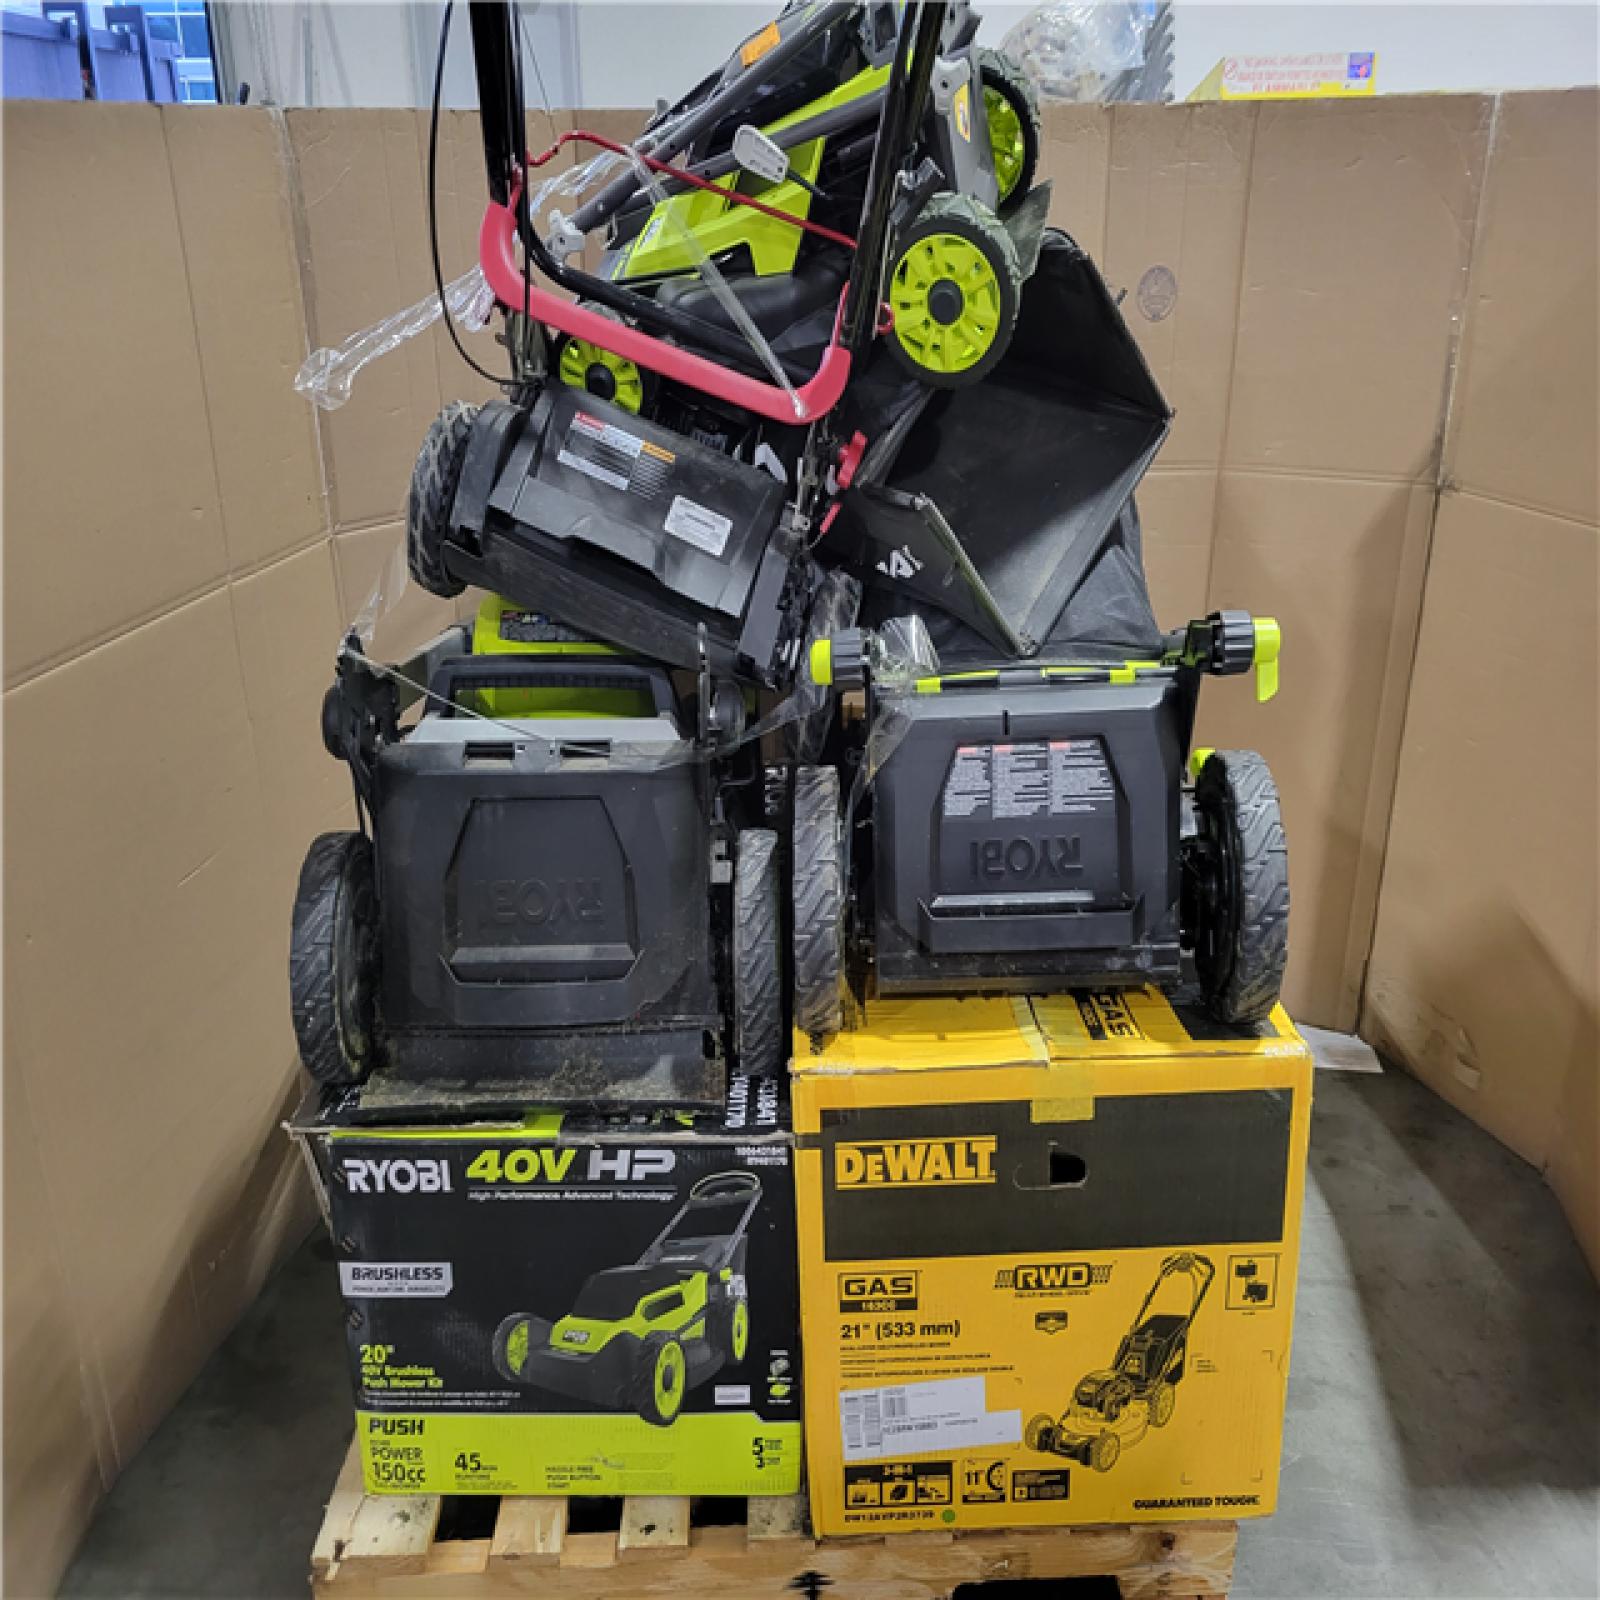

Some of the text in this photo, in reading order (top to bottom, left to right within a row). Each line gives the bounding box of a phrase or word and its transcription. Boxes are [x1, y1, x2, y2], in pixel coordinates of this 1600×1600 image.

[969, 834, 1083, 878] RYOBI
[342, 1159, 453, 1193] RYOBI
[465, 1149, 676, 1183] 40V HP
[352, 1267, 444, 1281] BRUSHLESS
[1016, 1265, 1090, 1289] RWD
[844, 1276, 913, 1296] GAS
[369, 1418, 426, 1436] PUSH
[371, 1447, 423, 1461] POWER
[454, 1452, 482, 1471] 45
[371, 1461, 426, 1483] 150cc
